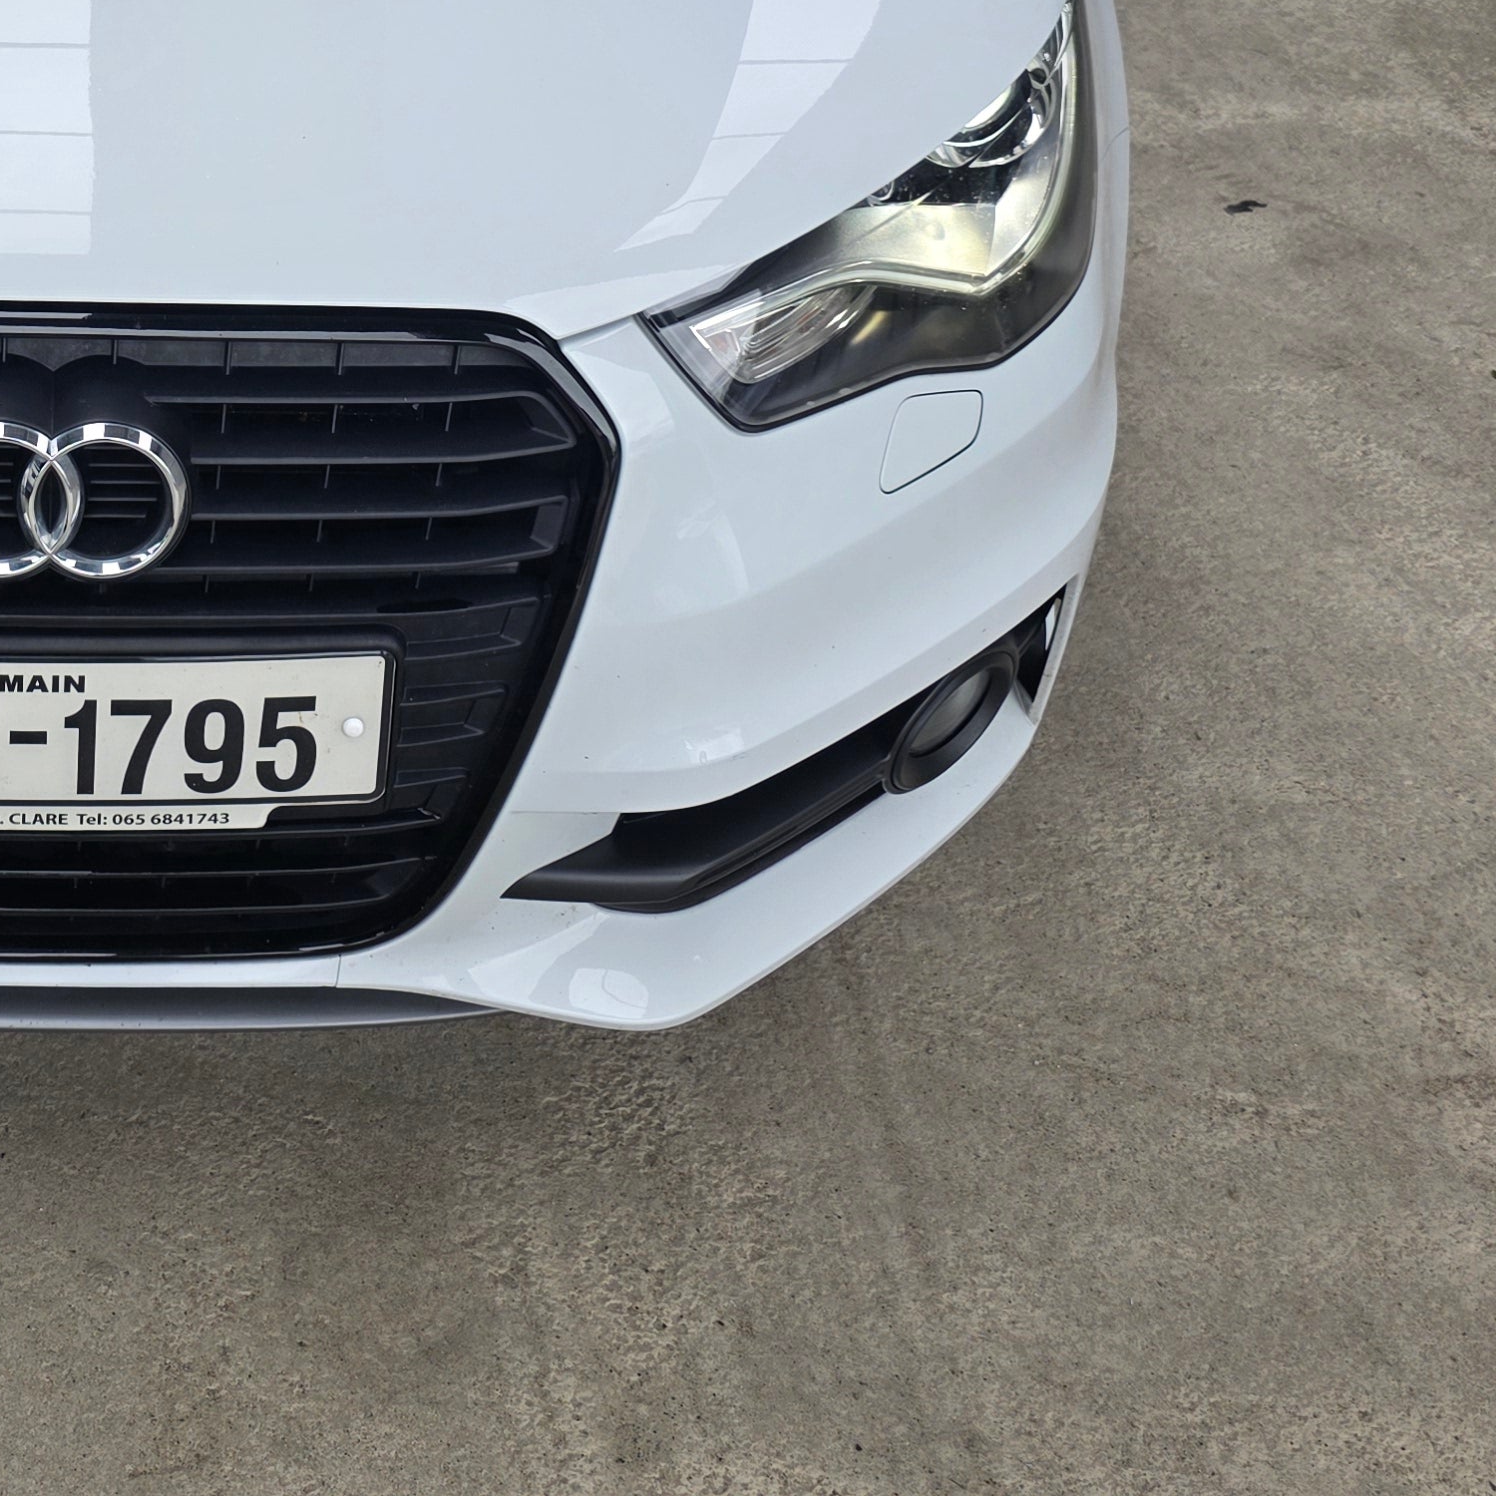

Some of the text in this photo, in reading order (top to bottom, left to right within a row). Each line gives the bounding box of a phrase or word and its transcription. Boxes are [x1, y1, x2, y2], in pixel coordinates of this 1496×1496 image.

[8, 812, 69, 826] CLARE
[76, 812, 108, 826] Tel:
[112, 813, 146, 826] 065
[150, 812, 230, 826] 6841743
